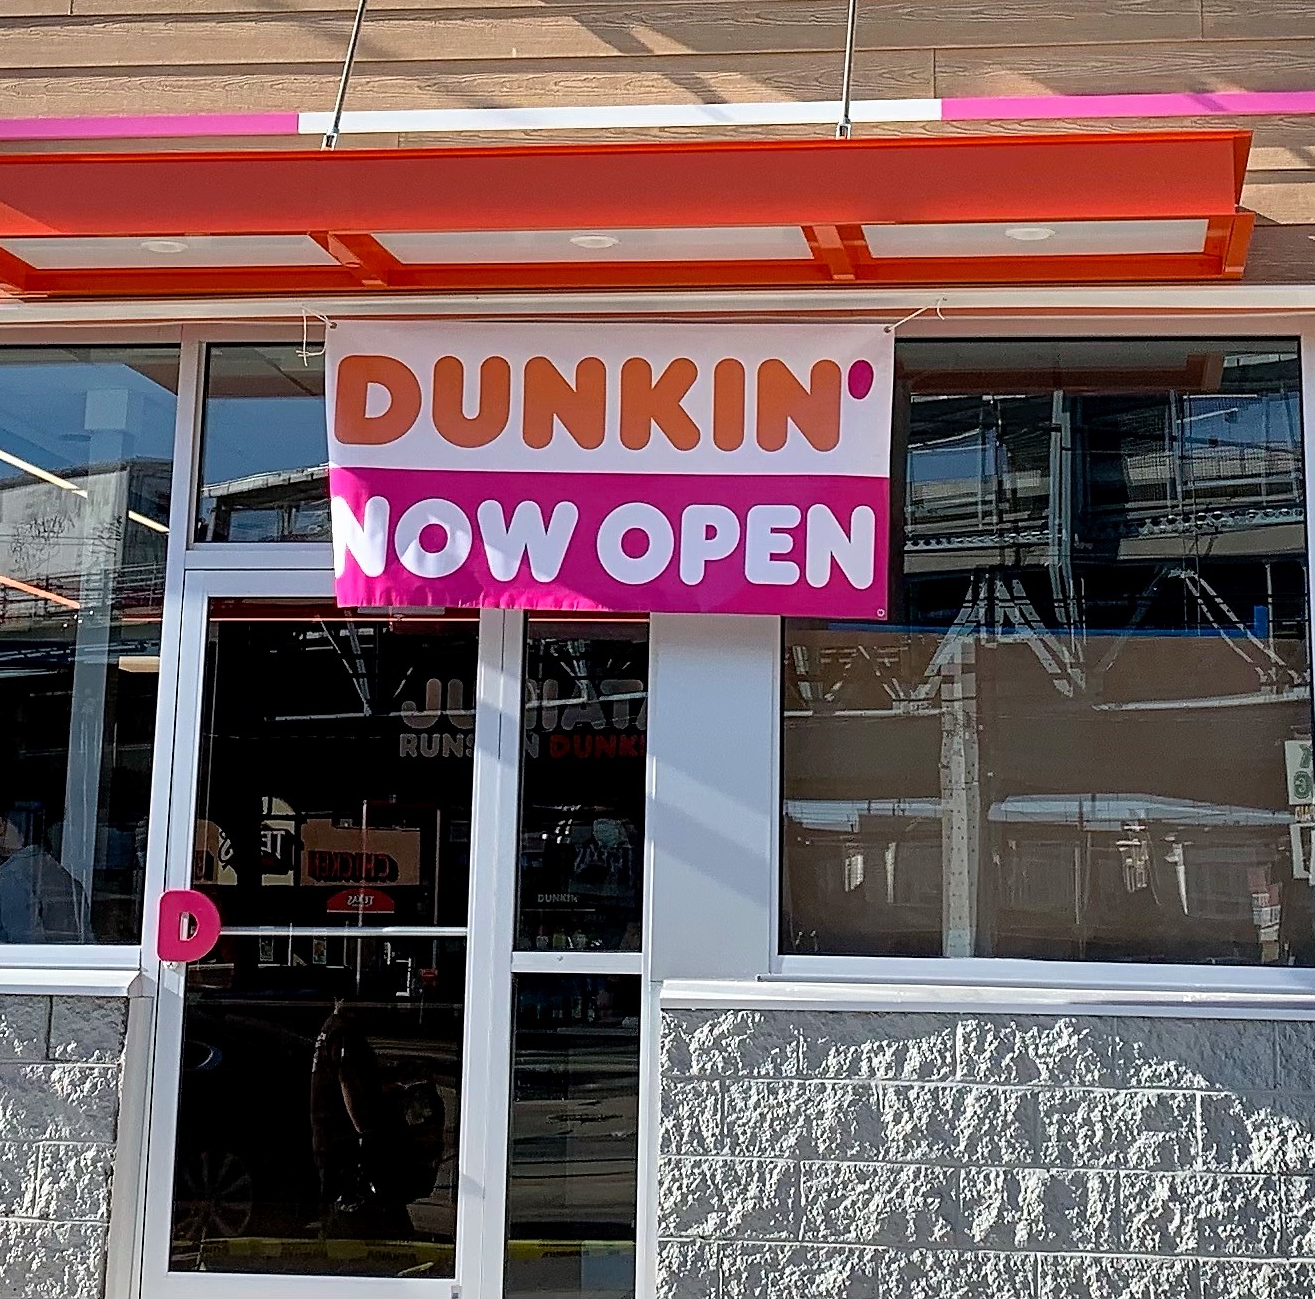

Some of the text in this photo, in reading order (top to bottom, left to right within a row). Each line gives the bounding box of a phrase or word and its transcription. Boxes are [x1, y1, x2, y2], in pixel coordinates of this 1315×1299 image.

[334, 354, 875, 452] DUNKIN'
[331, 496, 876, 590] NOW OPEN
[155, 889, 221, 962] D
